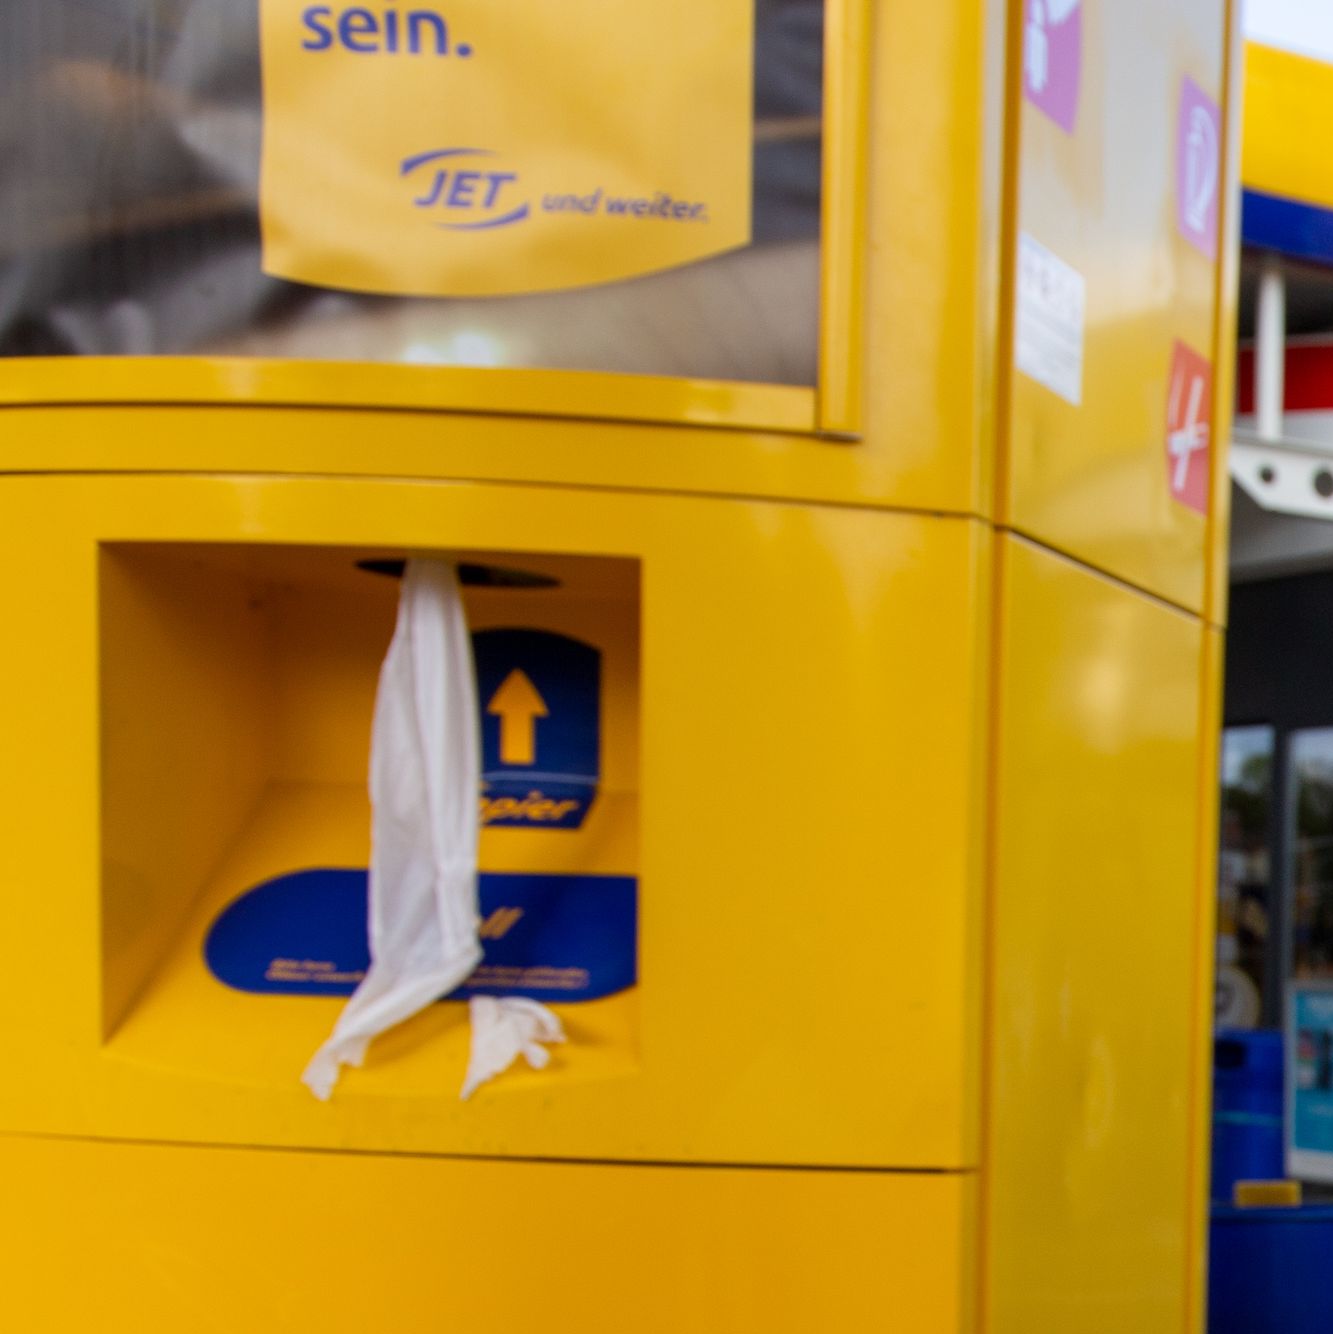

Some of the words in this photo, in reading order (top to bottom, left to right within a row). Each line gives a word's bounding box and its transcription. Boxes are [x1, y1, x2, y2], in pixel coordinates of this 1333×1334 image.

[302, 1, 472, 58] sein.
[413, 169, 518, 209] JET
[541, 187, 603, 214] und
[605, 191, 709, 224] weiter.
